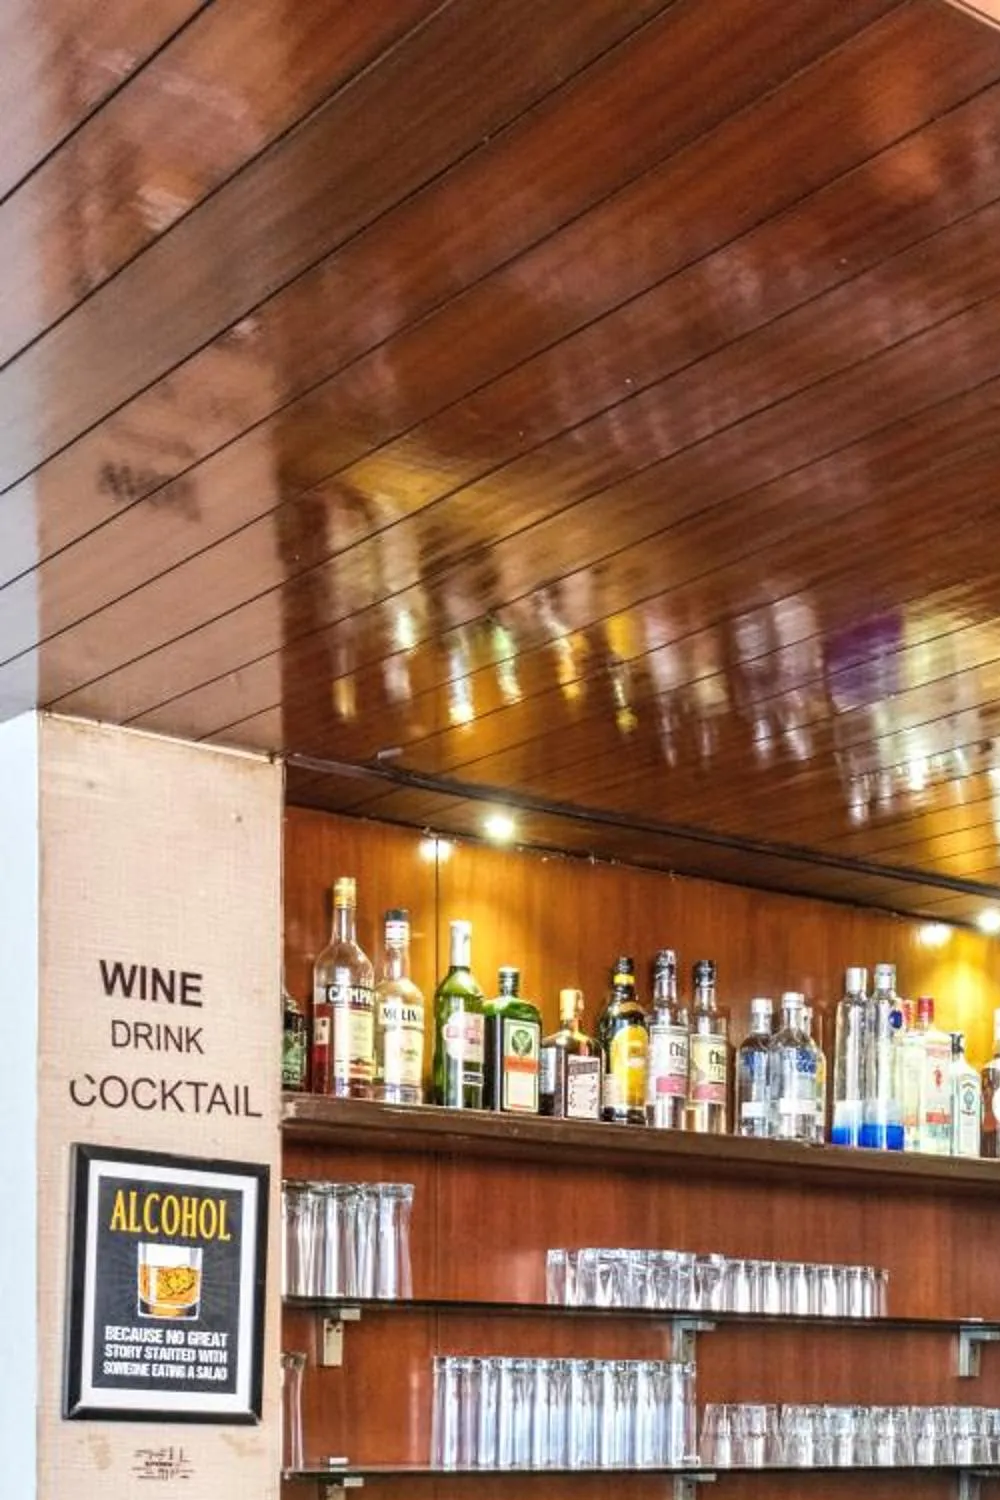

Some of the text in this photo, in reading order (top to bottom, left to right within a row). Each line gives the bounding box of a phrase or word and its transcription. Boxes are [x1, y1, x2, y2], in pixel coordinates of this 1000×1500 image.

[99, 959, 203, 1008] WINE
[111, 1019, 204, 1054] DRINK
[69, 1073, 263, 1117] COCKTAIL
[109, 1189, 231, 1240] ALCOHOL
[104, 1325, 228, 1348] BECAUSE NO GREAT
[104, 1343, 228, 1363] STORY STARTED WITH
[151, 1364, 186, 1379] EATING
[187, 1366, 195, 1379] A
[196, 1366, 228, 1381] SALAD
